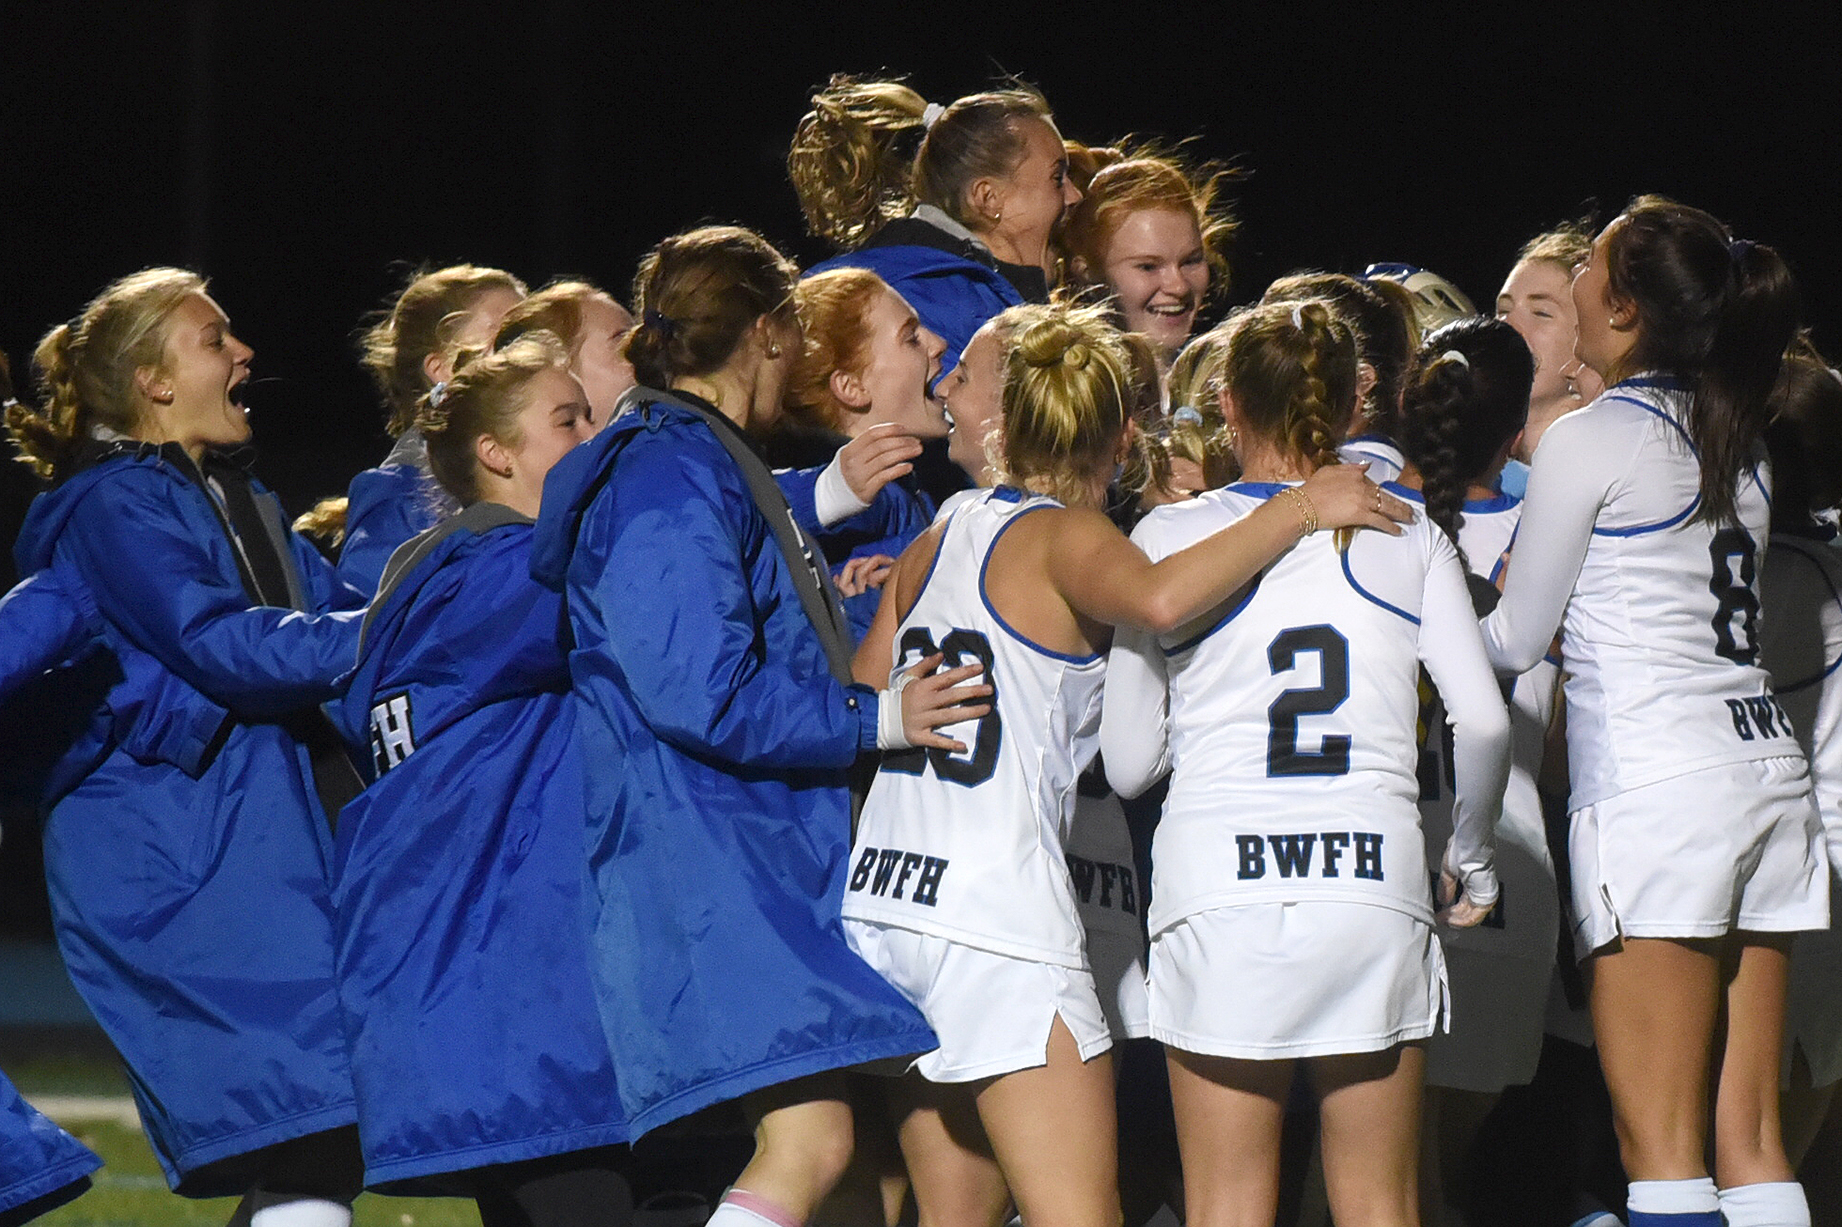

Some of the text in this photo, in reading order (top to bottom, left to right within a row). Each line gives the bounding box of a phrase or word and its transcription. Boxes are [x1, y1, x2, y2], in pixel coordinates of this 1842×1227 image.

[1709, 527, 1760, 667] 8
[1267, 623, 1352, 778] 2
[849, 846, 950, 908] BWFH
[1234, 832, 1385, 882] BWFH
